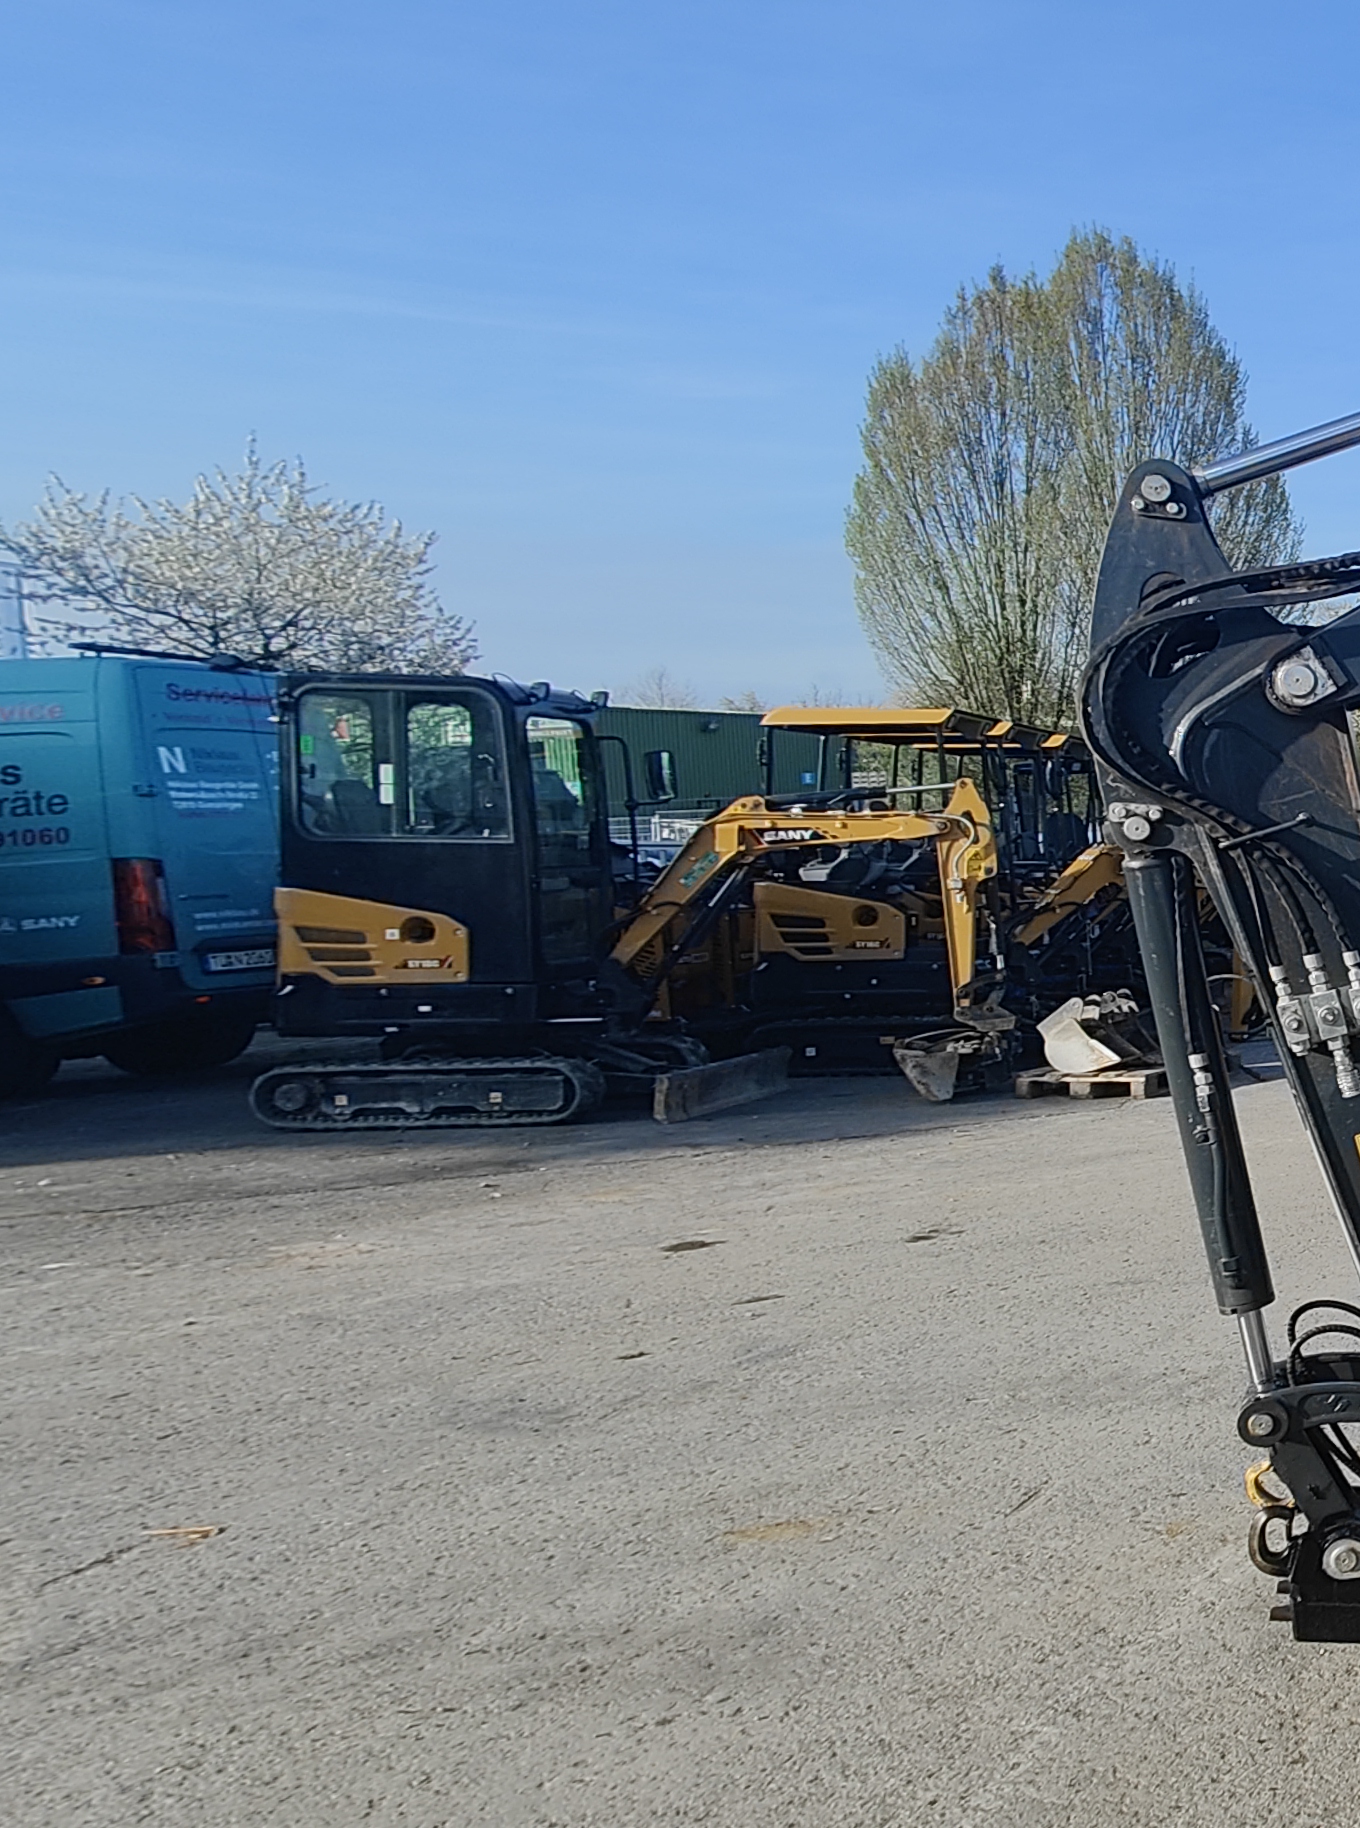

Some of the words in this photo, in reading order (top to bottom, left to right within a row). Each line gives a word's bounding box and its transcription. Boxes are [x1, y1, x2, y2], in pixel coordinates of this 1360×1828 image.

[157, 746, 187, 773] N
[763, 829, 814, 841] SANY
[21, 915, 81, 930] SANY
